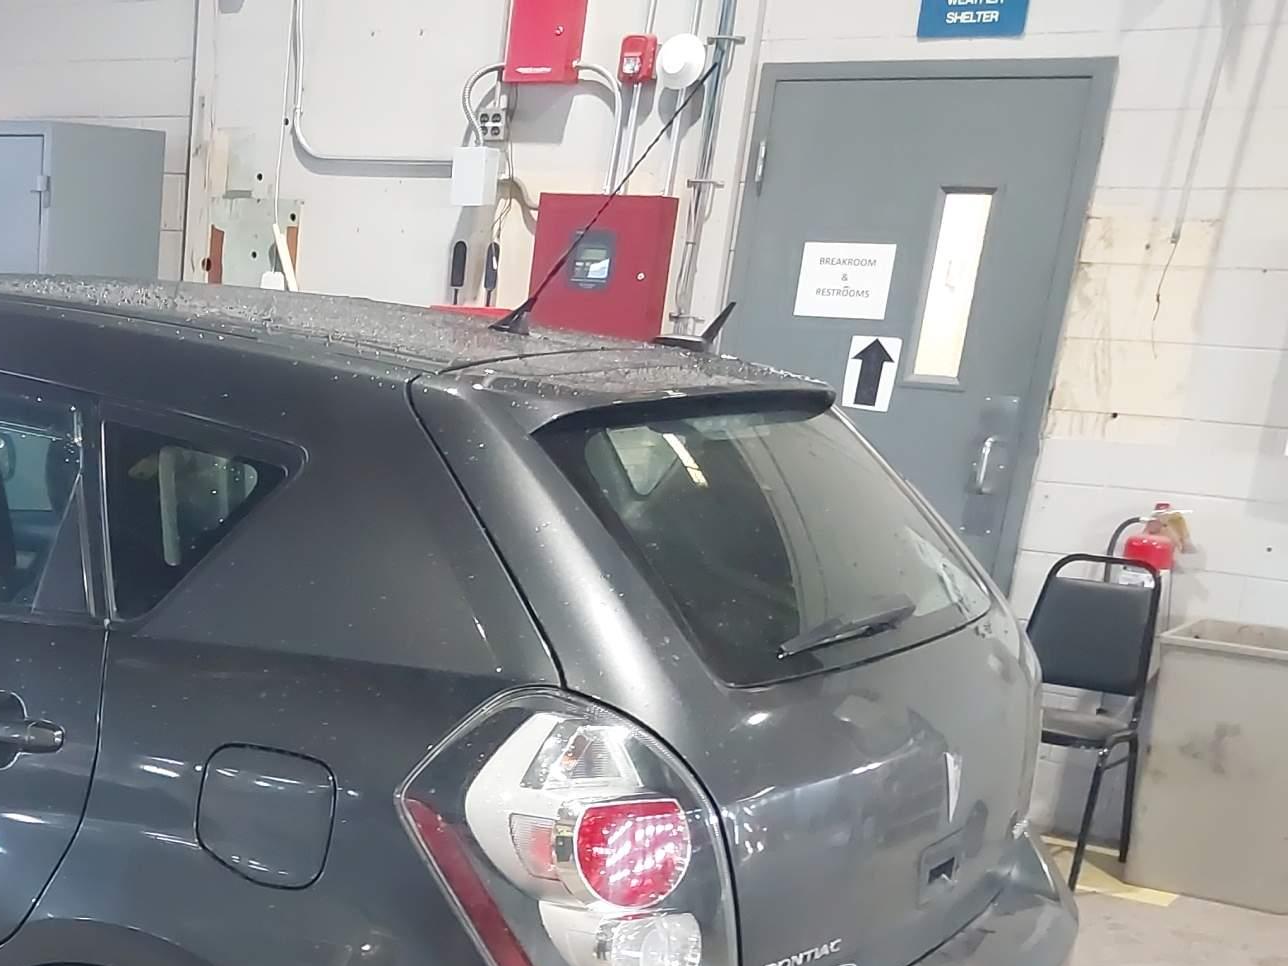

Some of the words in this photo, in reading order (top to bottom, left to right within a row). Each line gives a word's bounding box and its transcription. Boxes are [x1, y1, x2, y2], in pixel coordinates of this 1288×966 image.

[945, 10, 1000, 23] SHELTER
[819, 256, 877, 267] BREAKROOM
[841, 273, 848, 281] &
[815, 287, 870, 298] RESTROOMS
